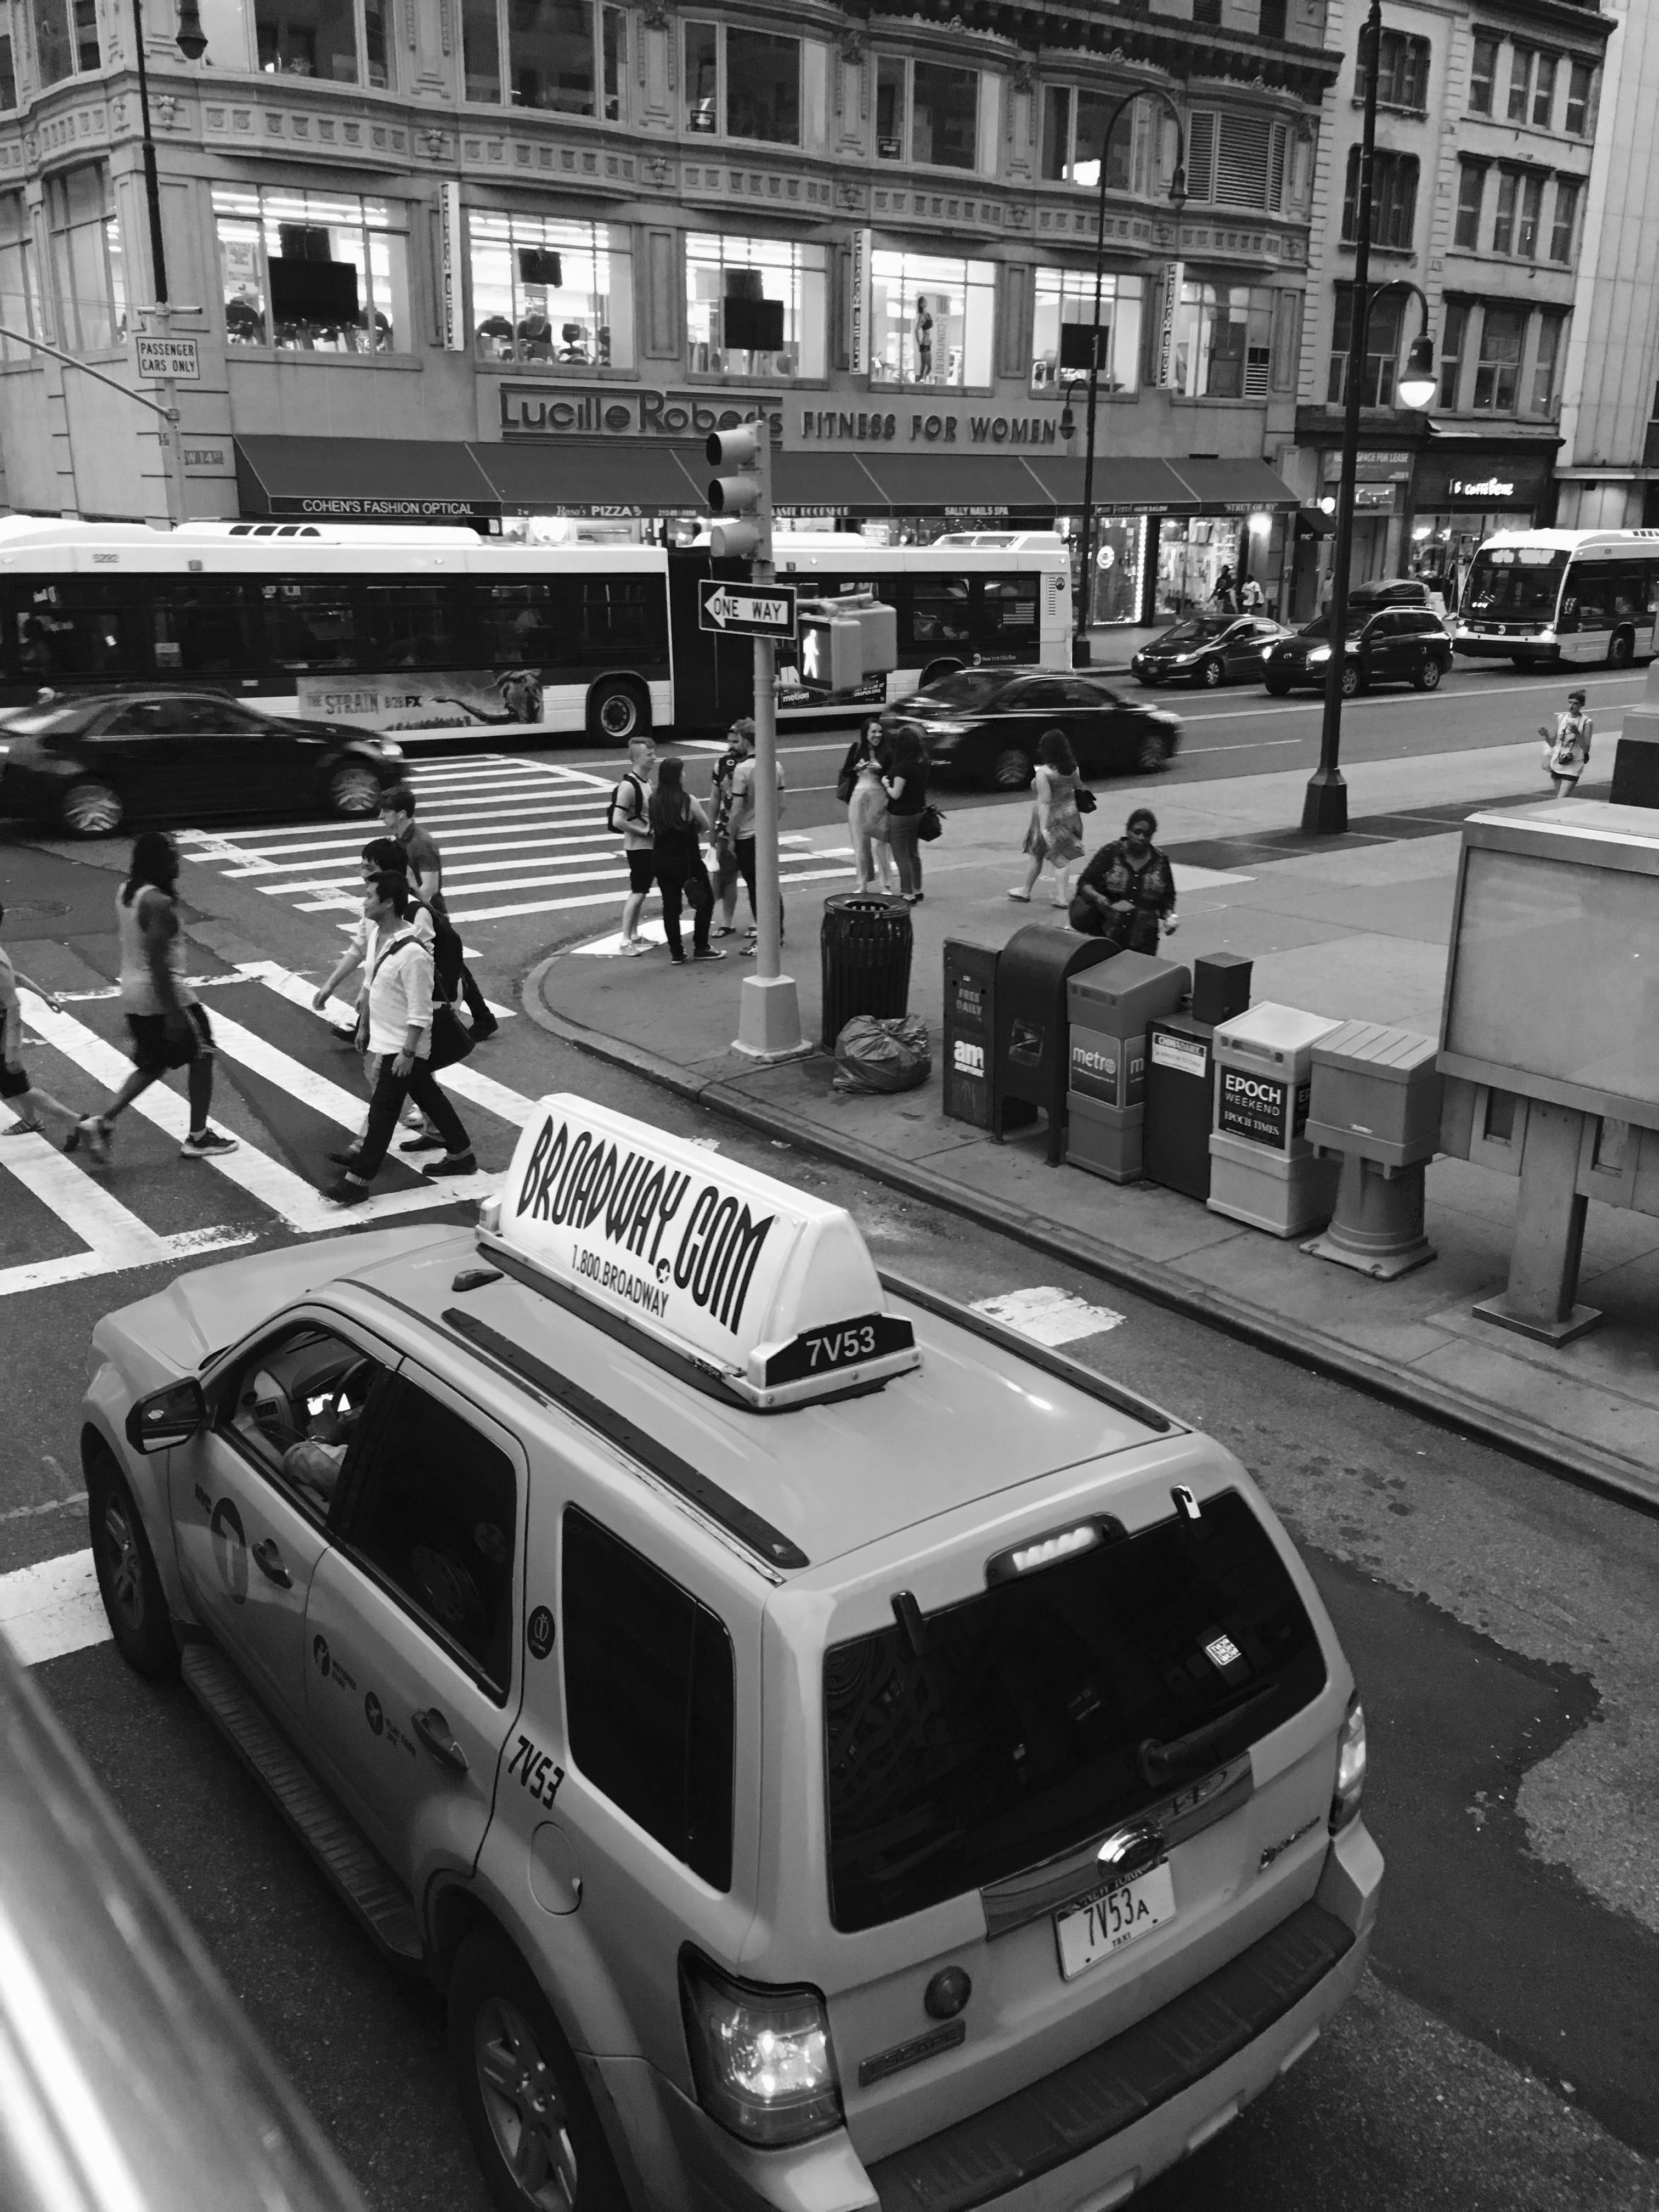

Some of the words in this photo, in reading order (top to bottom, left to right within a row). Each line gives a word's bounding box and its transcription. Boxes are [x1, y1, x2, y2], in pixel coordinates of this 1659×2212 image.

[140, 343, 194, 356] PASSENGER
[142, 359, 166, 371] CARS
[173, 359, 194, 372] ONLY
[500, 388, 631, 432] Lucille
[802, 410, 896, 439] FITNESS
[910, 415, 958, 442] FOR
[970, 416, 1056, 444] WOMEN
[1390, 453, 1409, 462] LEASE
[302, 499, 361, 512] COHEN'S
[364, 501, 419, 514] FASHION
[422, 503, 474, 515] OPTICAL
[556, 505, 586, 516] Rosa's
[591, 505, 632, 516] PIZZA
[944, 506, 969, 516] SALLY
[969, 506, 993, 516] NAILS
[994, 506, 1009, 516] SPA
[713, 597, 739, 618] ONE
[752, 601, 782, 621] WAY
[405, 695, 422, 707] FX
[782, 692, 809, 703] motion
[956, 999, 983, 1015] DAILY
[959, 988, 980, 1003] FREE
[953, 1040, 984, 1069] am
[1073, 1047, 1116, 1074] metro
[1225, 1074, 1282, 1105] EPOCH
[1224, 1092, 1281, 1116] WEEKEND
[1224, 1110, 1252, 1127] EPOCH
[1252, 1114, 1280, 1130] TIMES
[517, 1114, 776, 1336] BROADWAY.COM
[572, 1244, 670, 1318] 1.800.BROADWAY
[806, 1326, 876, 1367] 7V53
[508, 1735, 565, 1811] 7V53
[1084, 1888, 1150, 1946] 7V53A
[1111, 1932, 1131, 1948] TAXI
[871, 2027, 959, 2075] ESCAPE
